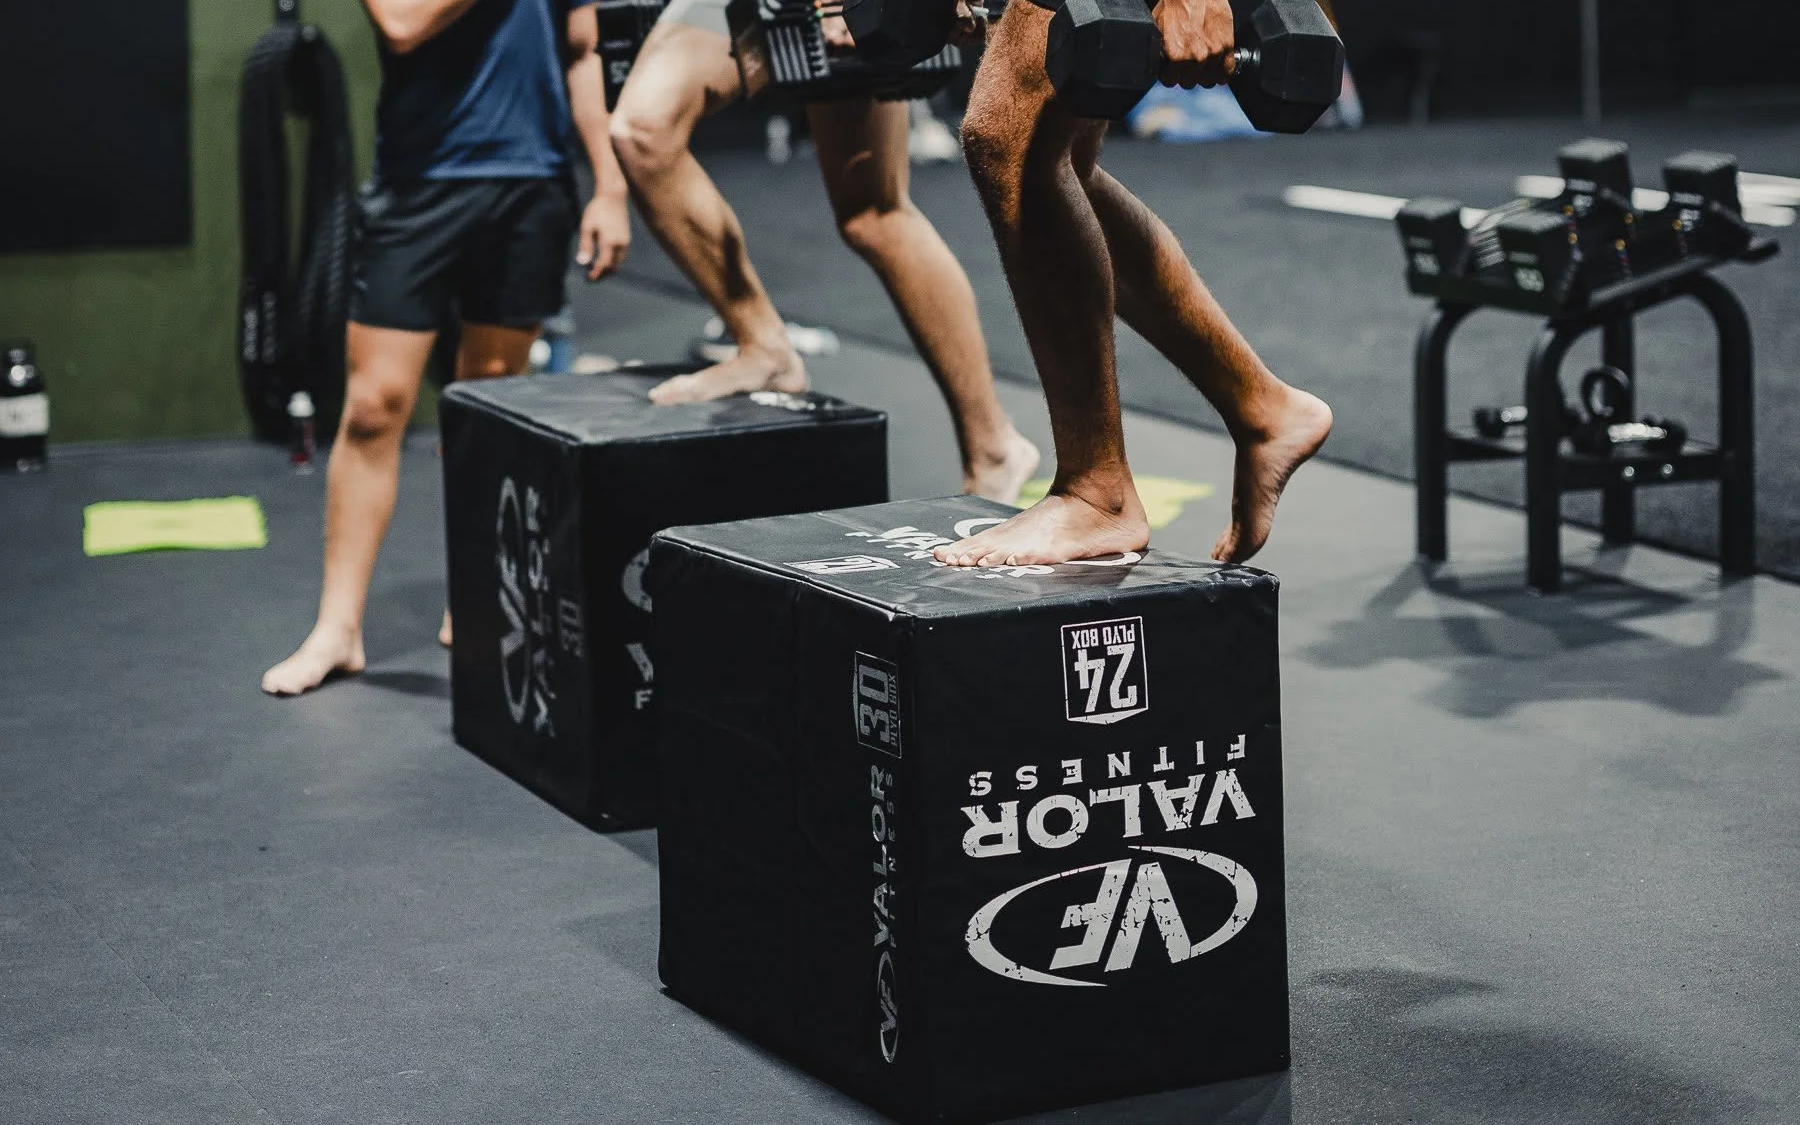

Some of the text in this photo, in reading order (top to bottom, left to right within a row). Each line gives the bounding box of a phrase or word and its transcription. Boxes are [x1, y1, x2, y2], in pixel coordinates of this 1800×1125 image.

[1070, 623, 1136, 650] PLYO BOX
[858, 664, 891, 744] 30
[887, 673, 898, 747] PLYO BOX
[1074, 642, 1138, 713] 24
[968, 734, 1246, 797] FITNESS
[960, 768, 1257, 859] VALOR
[870, 764, 890, 947] VALOR
[885, 772, 898, 948] FITNESS
